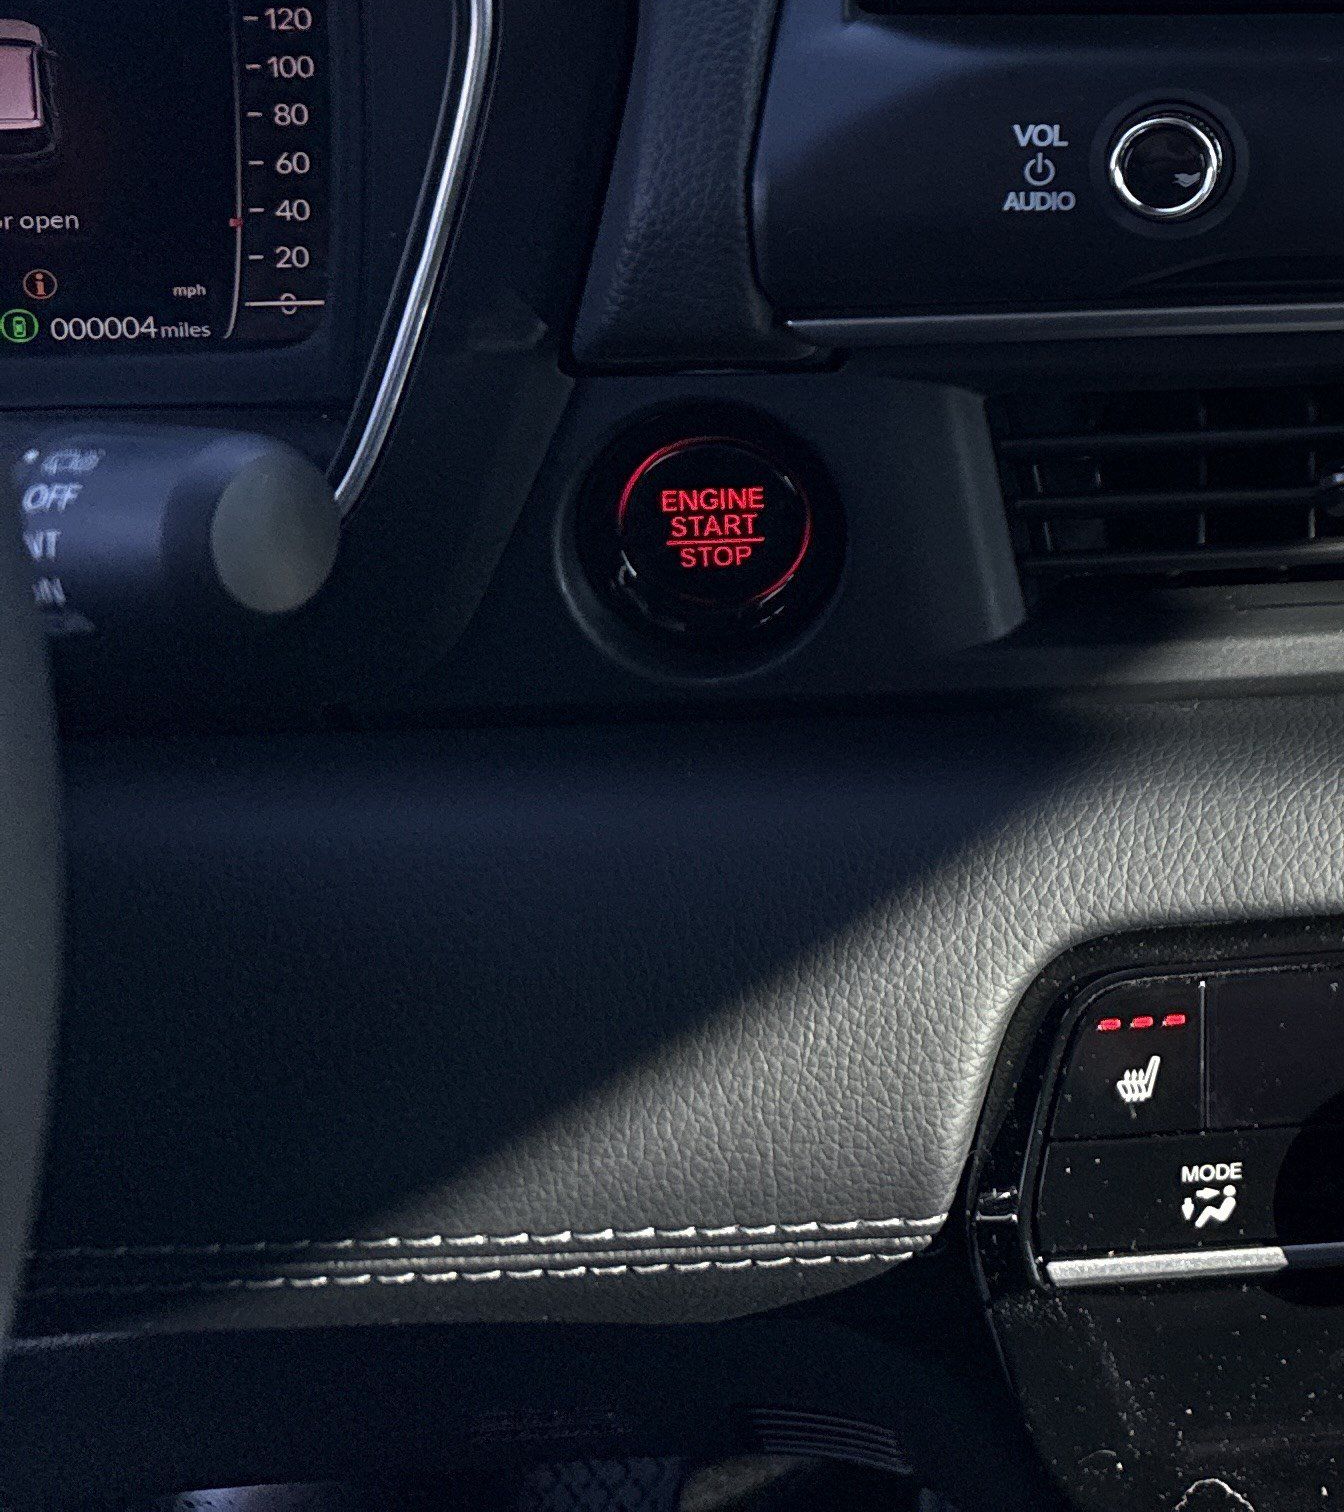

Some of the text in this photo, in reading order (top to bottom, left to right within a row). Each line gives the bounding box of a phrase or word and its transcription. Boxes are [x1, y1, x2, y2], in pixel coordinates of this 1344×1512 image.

[264, 7, 313, 31] 120
[267, 55, 316, 79] 100
[274, 102, 309, 127] 80
[1012, 123, 1069, 148] VOL
[275, 151, 311, 175] 60
[275, 198, 312, 222] 40
[1002, 190, 1077, 212] AUDIO
[19, 214, 80, 233] open
[275, 245, 310, 269] 20
[172, 284, 207, 299] mph
[50, 315, 212, 341] 000004 miles
[22, 482, 84, 514] OFF
[660, 486, 766, 514] ENGINE
[670, 513, 757, 538] START
[679, 544, 753, 570] STOP
[1181, 1161, 1244, 1184] MODE
